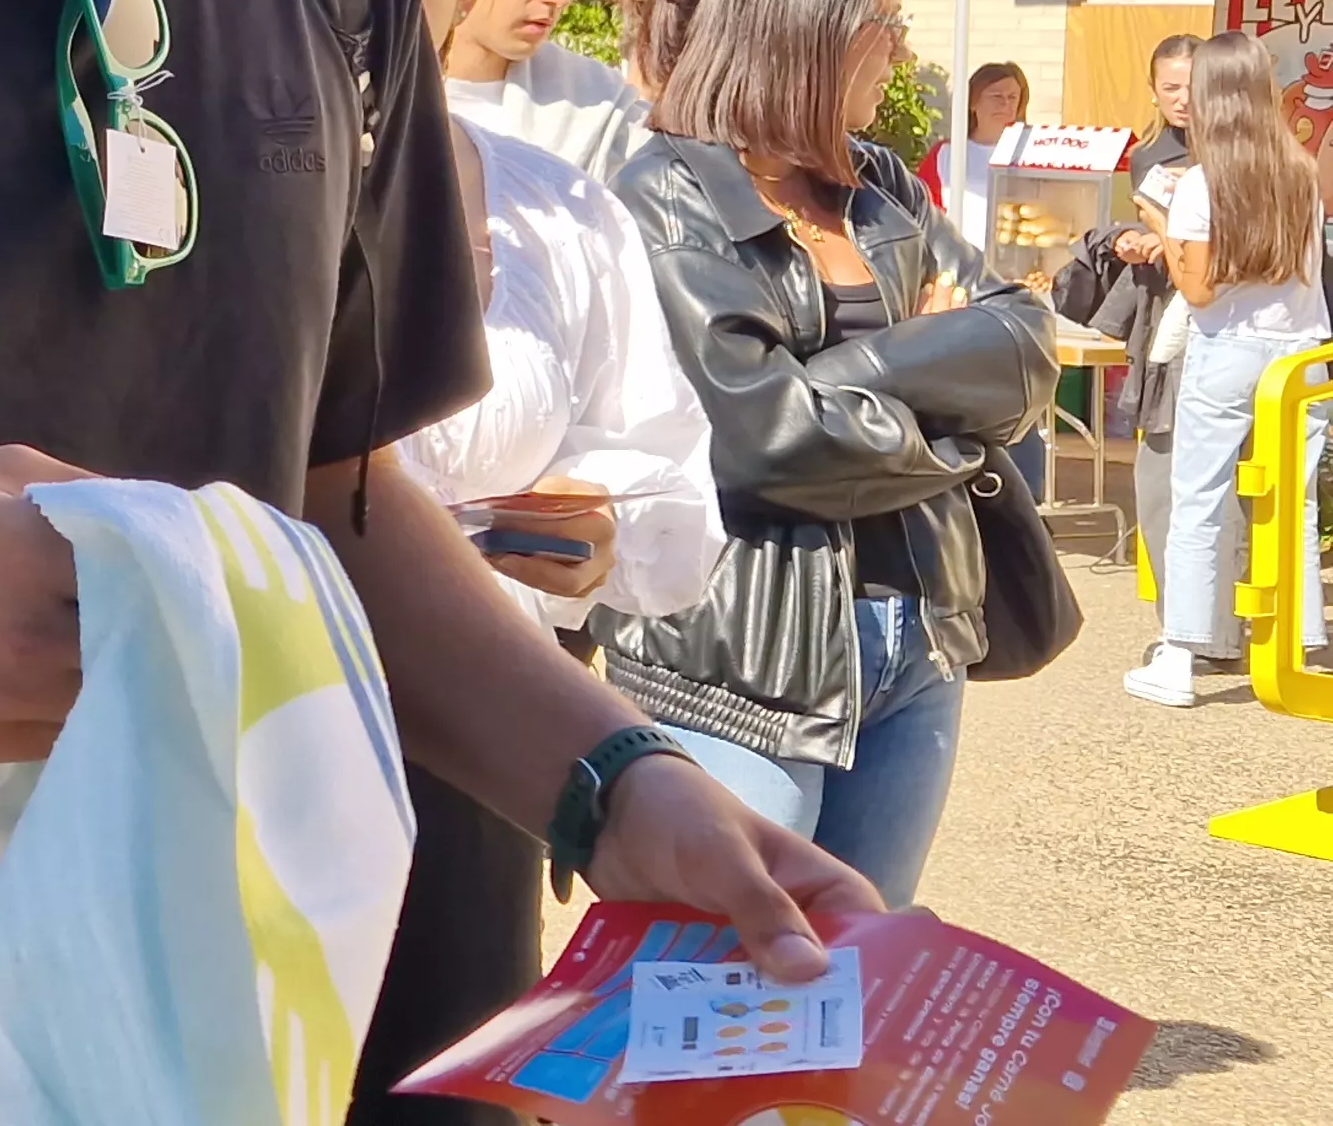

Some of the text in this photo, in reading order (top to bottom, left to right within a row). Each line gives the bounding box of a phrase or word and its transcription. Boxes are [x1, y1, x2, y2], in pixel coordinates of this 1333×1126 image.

[1033, 136, 1091, 150] HOT DOG
[259, 146, 327, 174] adidas
[991, 977, 1041, 1048] siempre
[1020, 1028, 1042, 1049] tu
